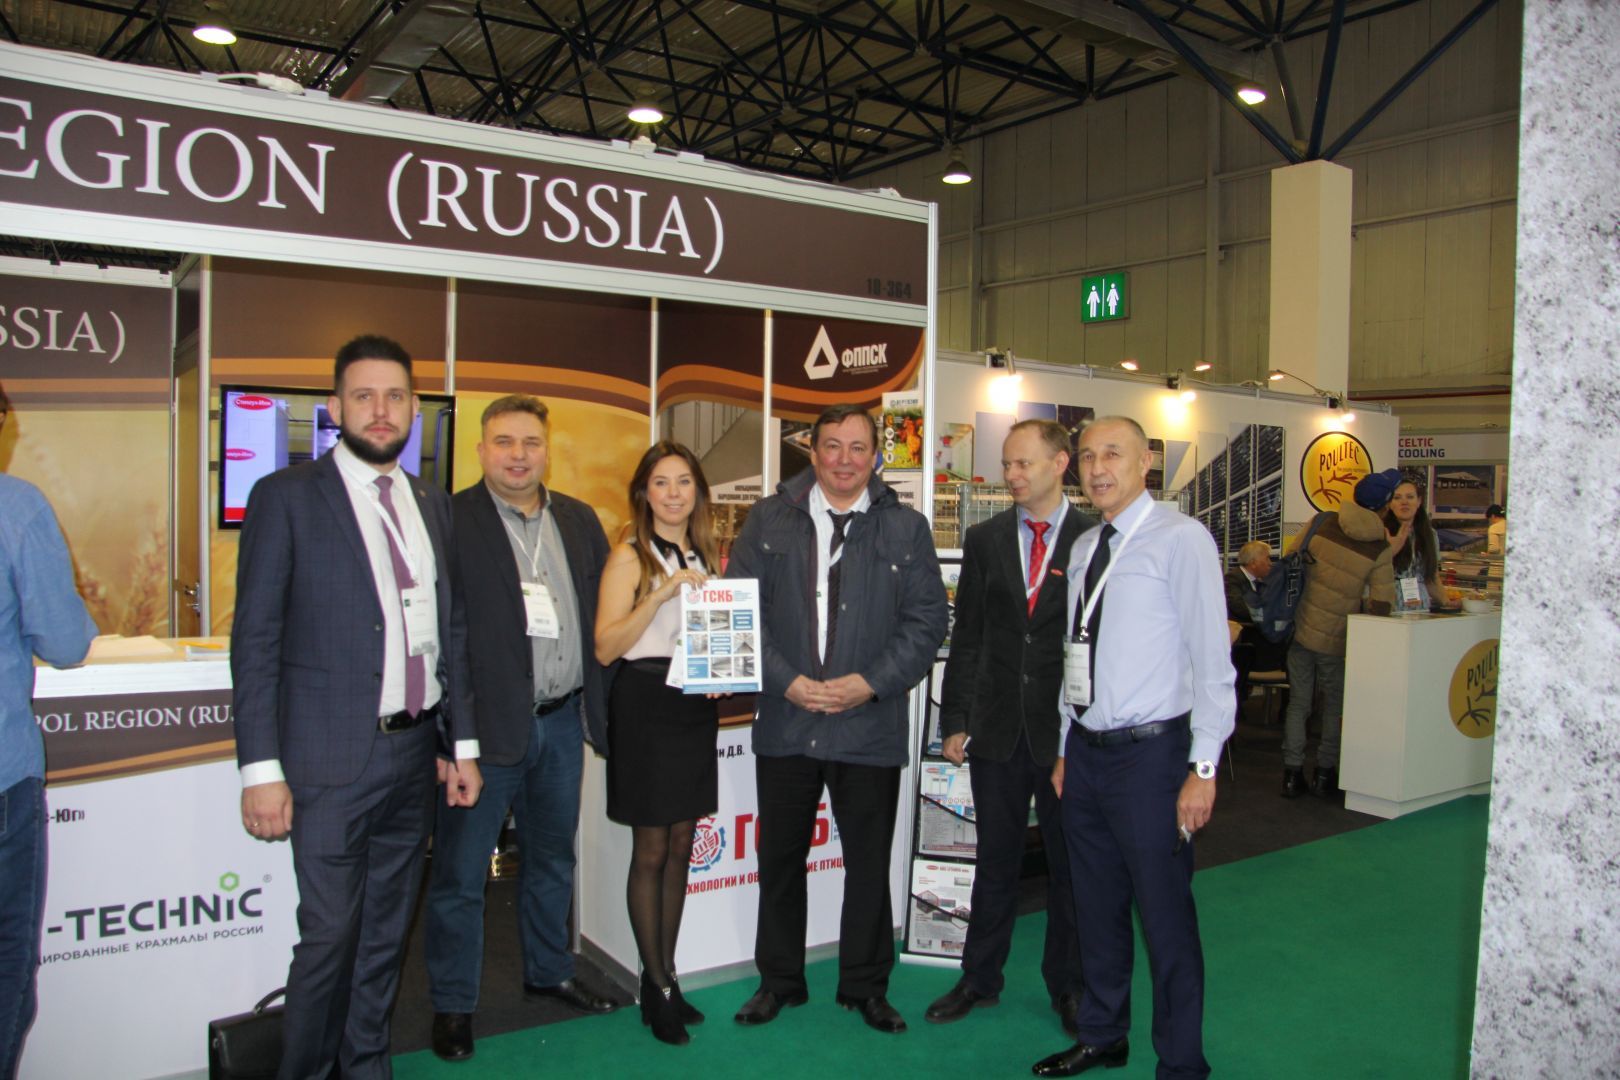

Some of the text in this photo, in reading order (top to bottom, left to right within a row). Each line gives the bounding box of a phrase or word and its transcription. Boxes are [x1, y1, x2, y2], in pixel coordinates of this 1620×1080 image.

[387, 151, 724, 274] (RUSSIA)
[841, 343, 888, 368] ФППСК
[1398, 437, 1434, 448] CELTIC
[1398, 448, 1445, 458] COOLING
[1319, 440, 1360, 472] POULTEC
[703, 589, 733, 603] ГСКБ
[84, 707, 182, 731] REGION
[188, 704, 234, 728] (RU
[727, 744, 745, 759] Д.В.
[38, 925, 263, 966] ИРОВАННЫЕ КРАХМАЛЫ РОССИИ
